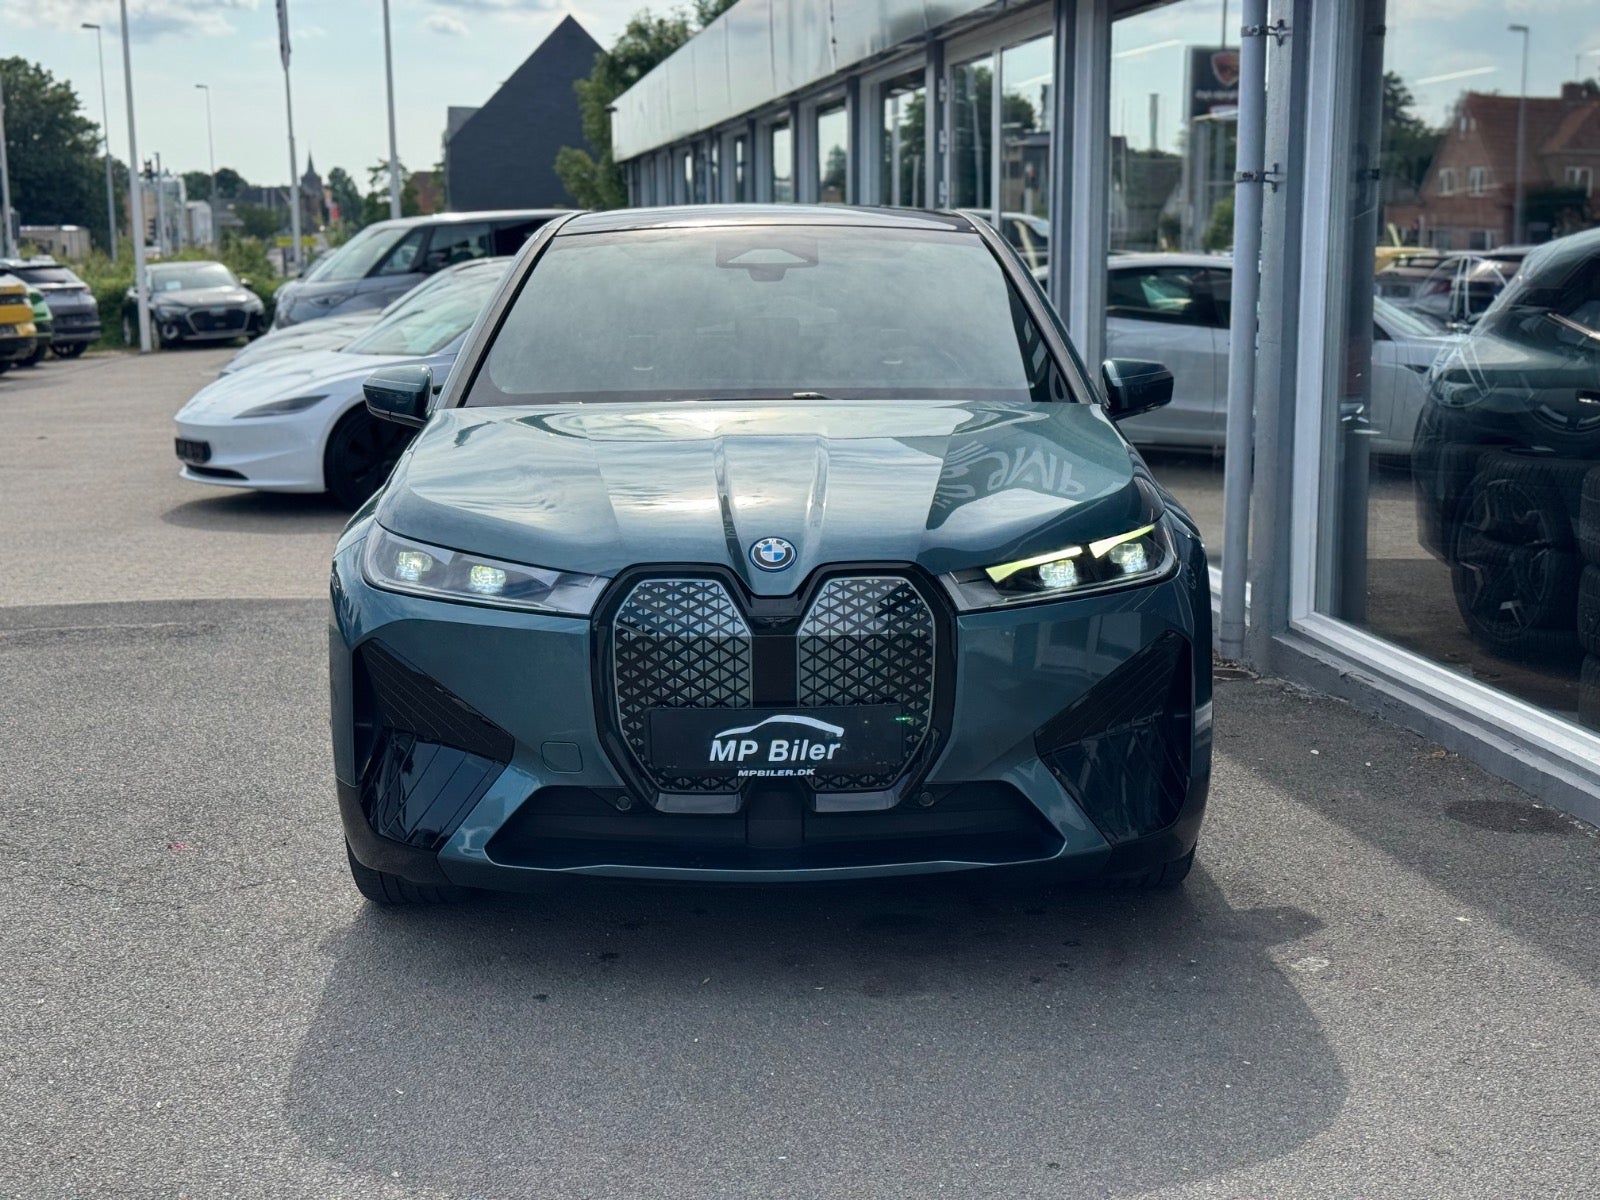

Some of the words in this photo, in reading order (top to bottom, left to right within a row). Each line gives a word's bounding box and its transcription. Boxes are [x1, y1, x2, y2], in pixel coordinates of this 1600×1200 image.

[709, 739, 759, 762] MP
[768, 739, 841, 762] Biler
[737, 768, 816, 777] MPBILER.DK
